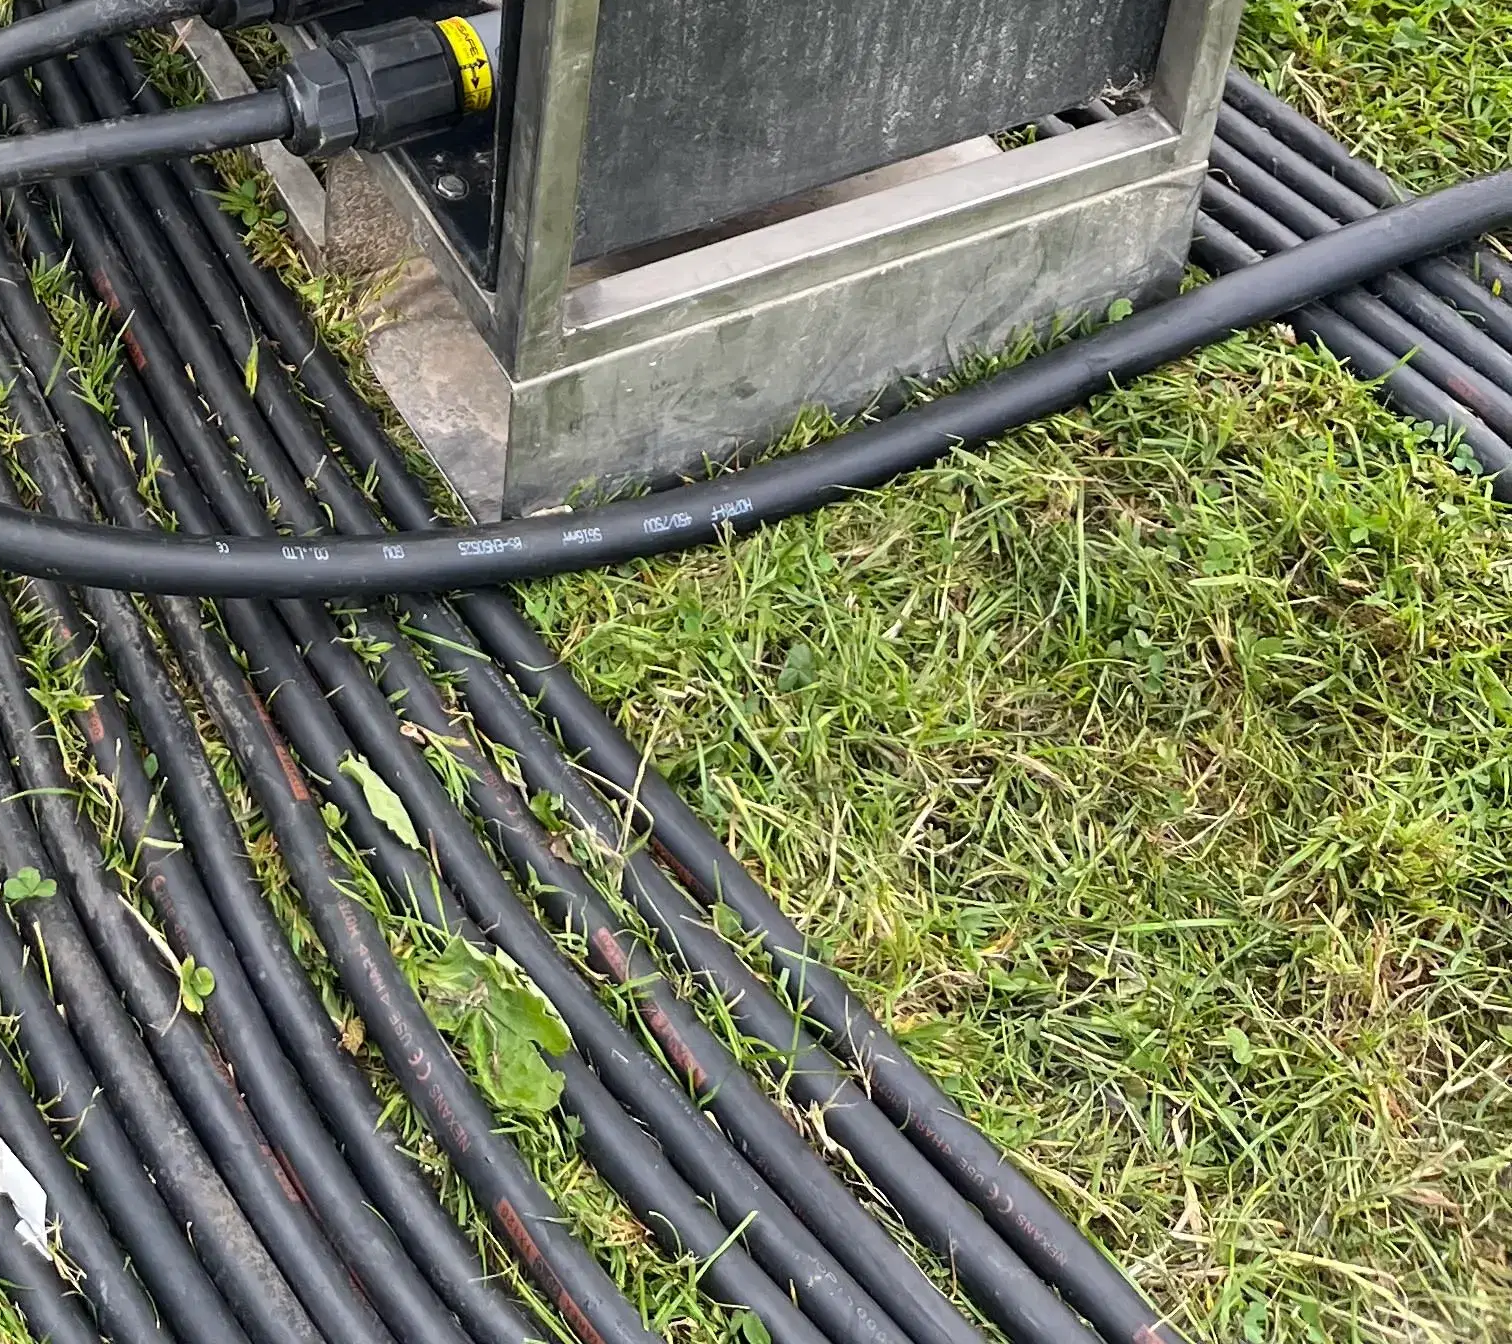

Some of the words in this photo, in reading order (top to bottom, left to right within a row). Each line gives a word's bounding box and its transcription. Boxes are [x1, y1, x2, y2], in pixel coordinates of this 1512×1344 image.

[643, 512, 693, 535] 450/750V
[388, 1011, 413, 1048] USE
[428, 1084, 471, 1154] NEXANS
